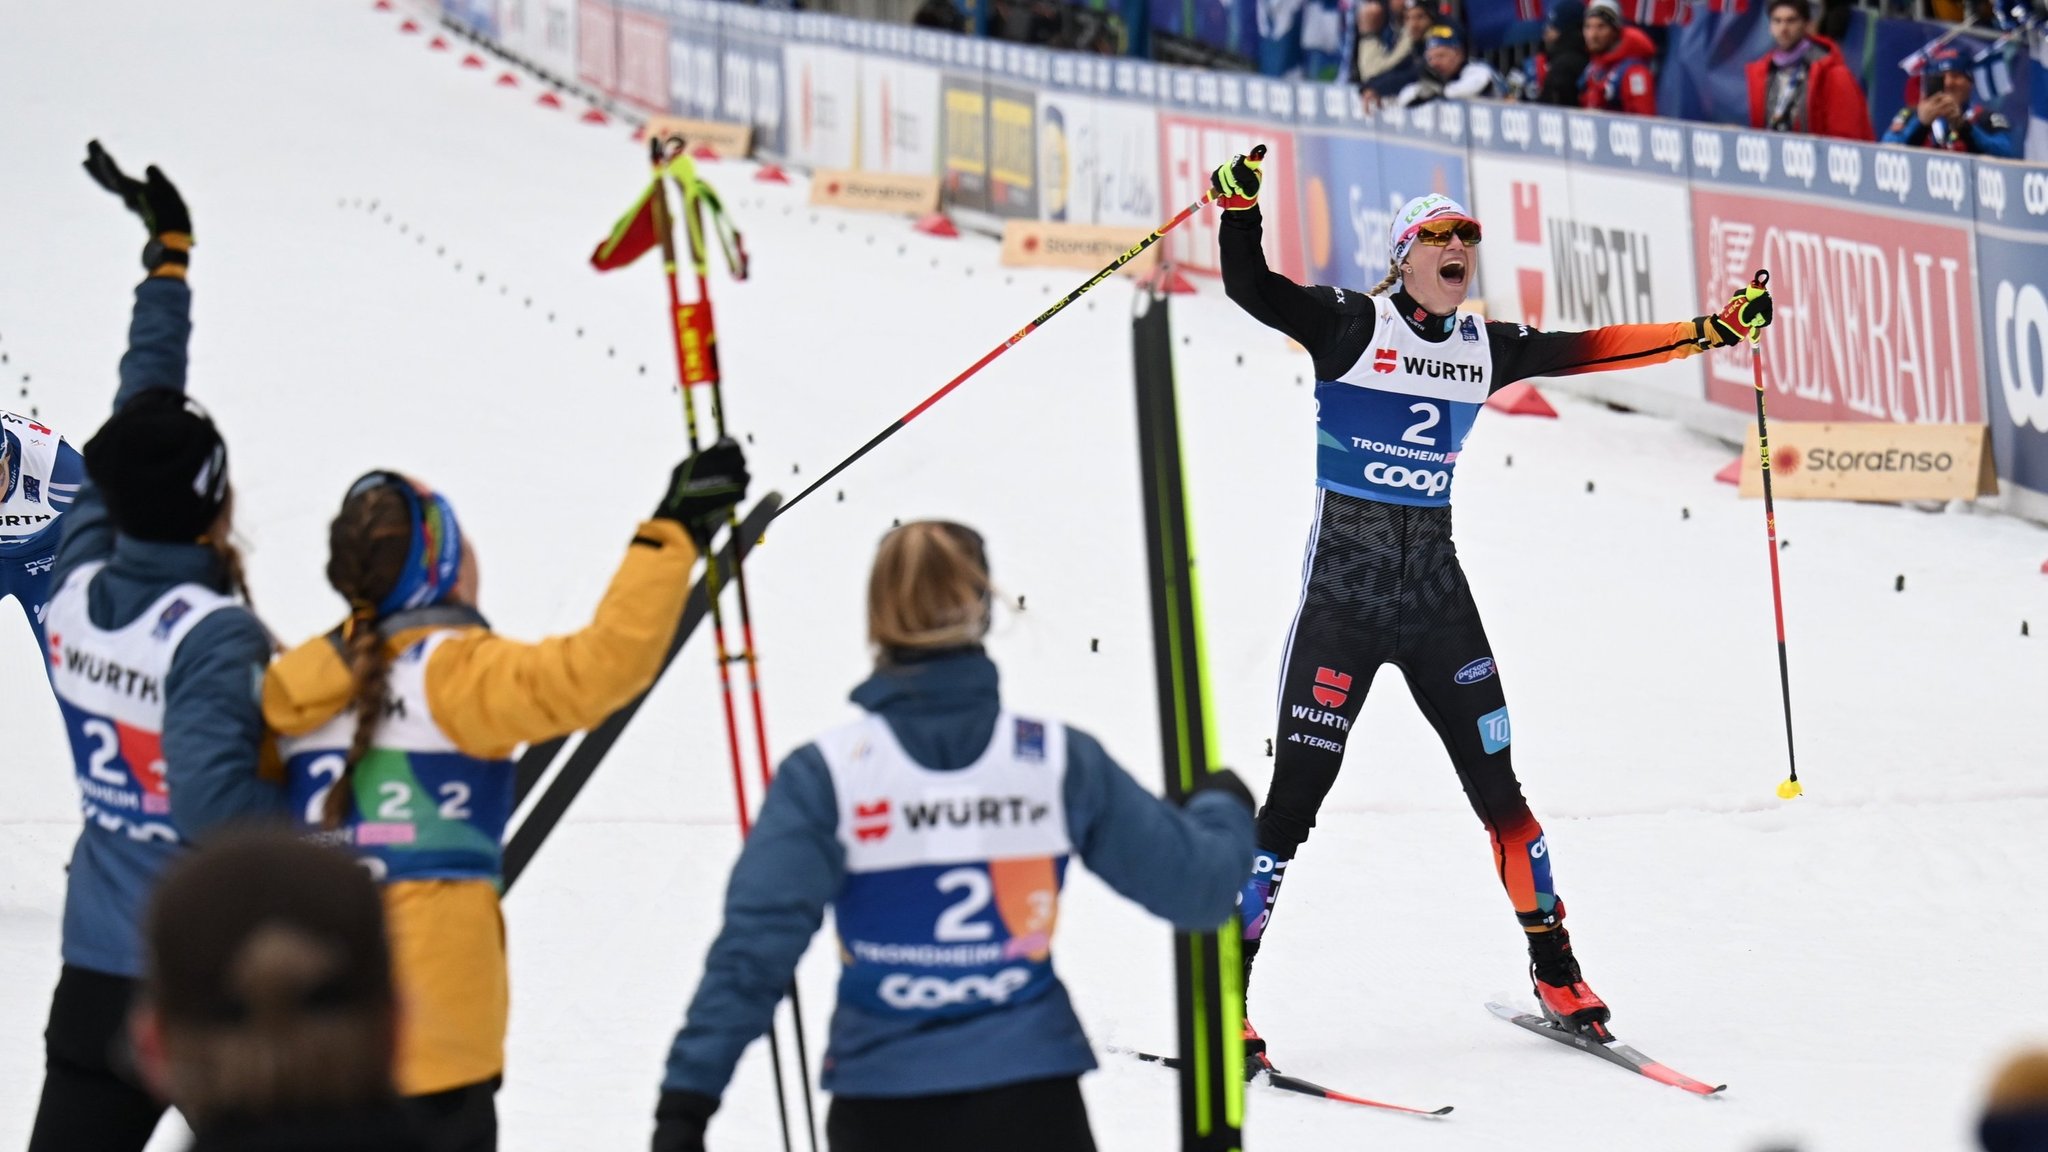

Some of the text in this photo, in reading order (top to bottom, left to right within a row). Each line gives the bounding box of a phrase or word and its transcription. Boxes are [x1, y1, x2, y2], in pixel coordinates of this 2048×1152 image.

[1569, 116, 1597, 160] coop
[1609, 121, 1641, 166] coop
[1650, 126, 1683, 173] coop
[1692, 131, 1723, 178] coop
[1736, 135, 1770, 183] coop
[1782, 139, 1816, 189] coop
[1828, 144, 1861, 196] coop
[1874, 152, 1911, 204] coop
[1926, 158, 1965, 212] coop
[1977, 166, 2006, 220] coop
[1548, 216, 1655, 325] WÜRTH
[1724, 298, 1744, 319] LEKI
[1761, 226, 1961, 425] GENERALI
[1403, 356, 1484, 383] WÜRTH
[1996, 279, 2048, 433] co
[1401, 402, 1441, 446] 2
[1351, 436, 1445, 463] TRONDHEIM
[1807, 448, 1953, 472] StoraEnso
[1363, 461, 1449, 497] coop
[1458, 660, 1493, 681] personal
[1468, 668, 1488, 681] shop
[1291, 704, 1350, 732] WÜRTH
[83, 718, 128, 785] 2
[1303, 734, 1343, 754] TERREX
[377, 781, 472, 820] 2 2
[933, 866, 994, 943] 2
